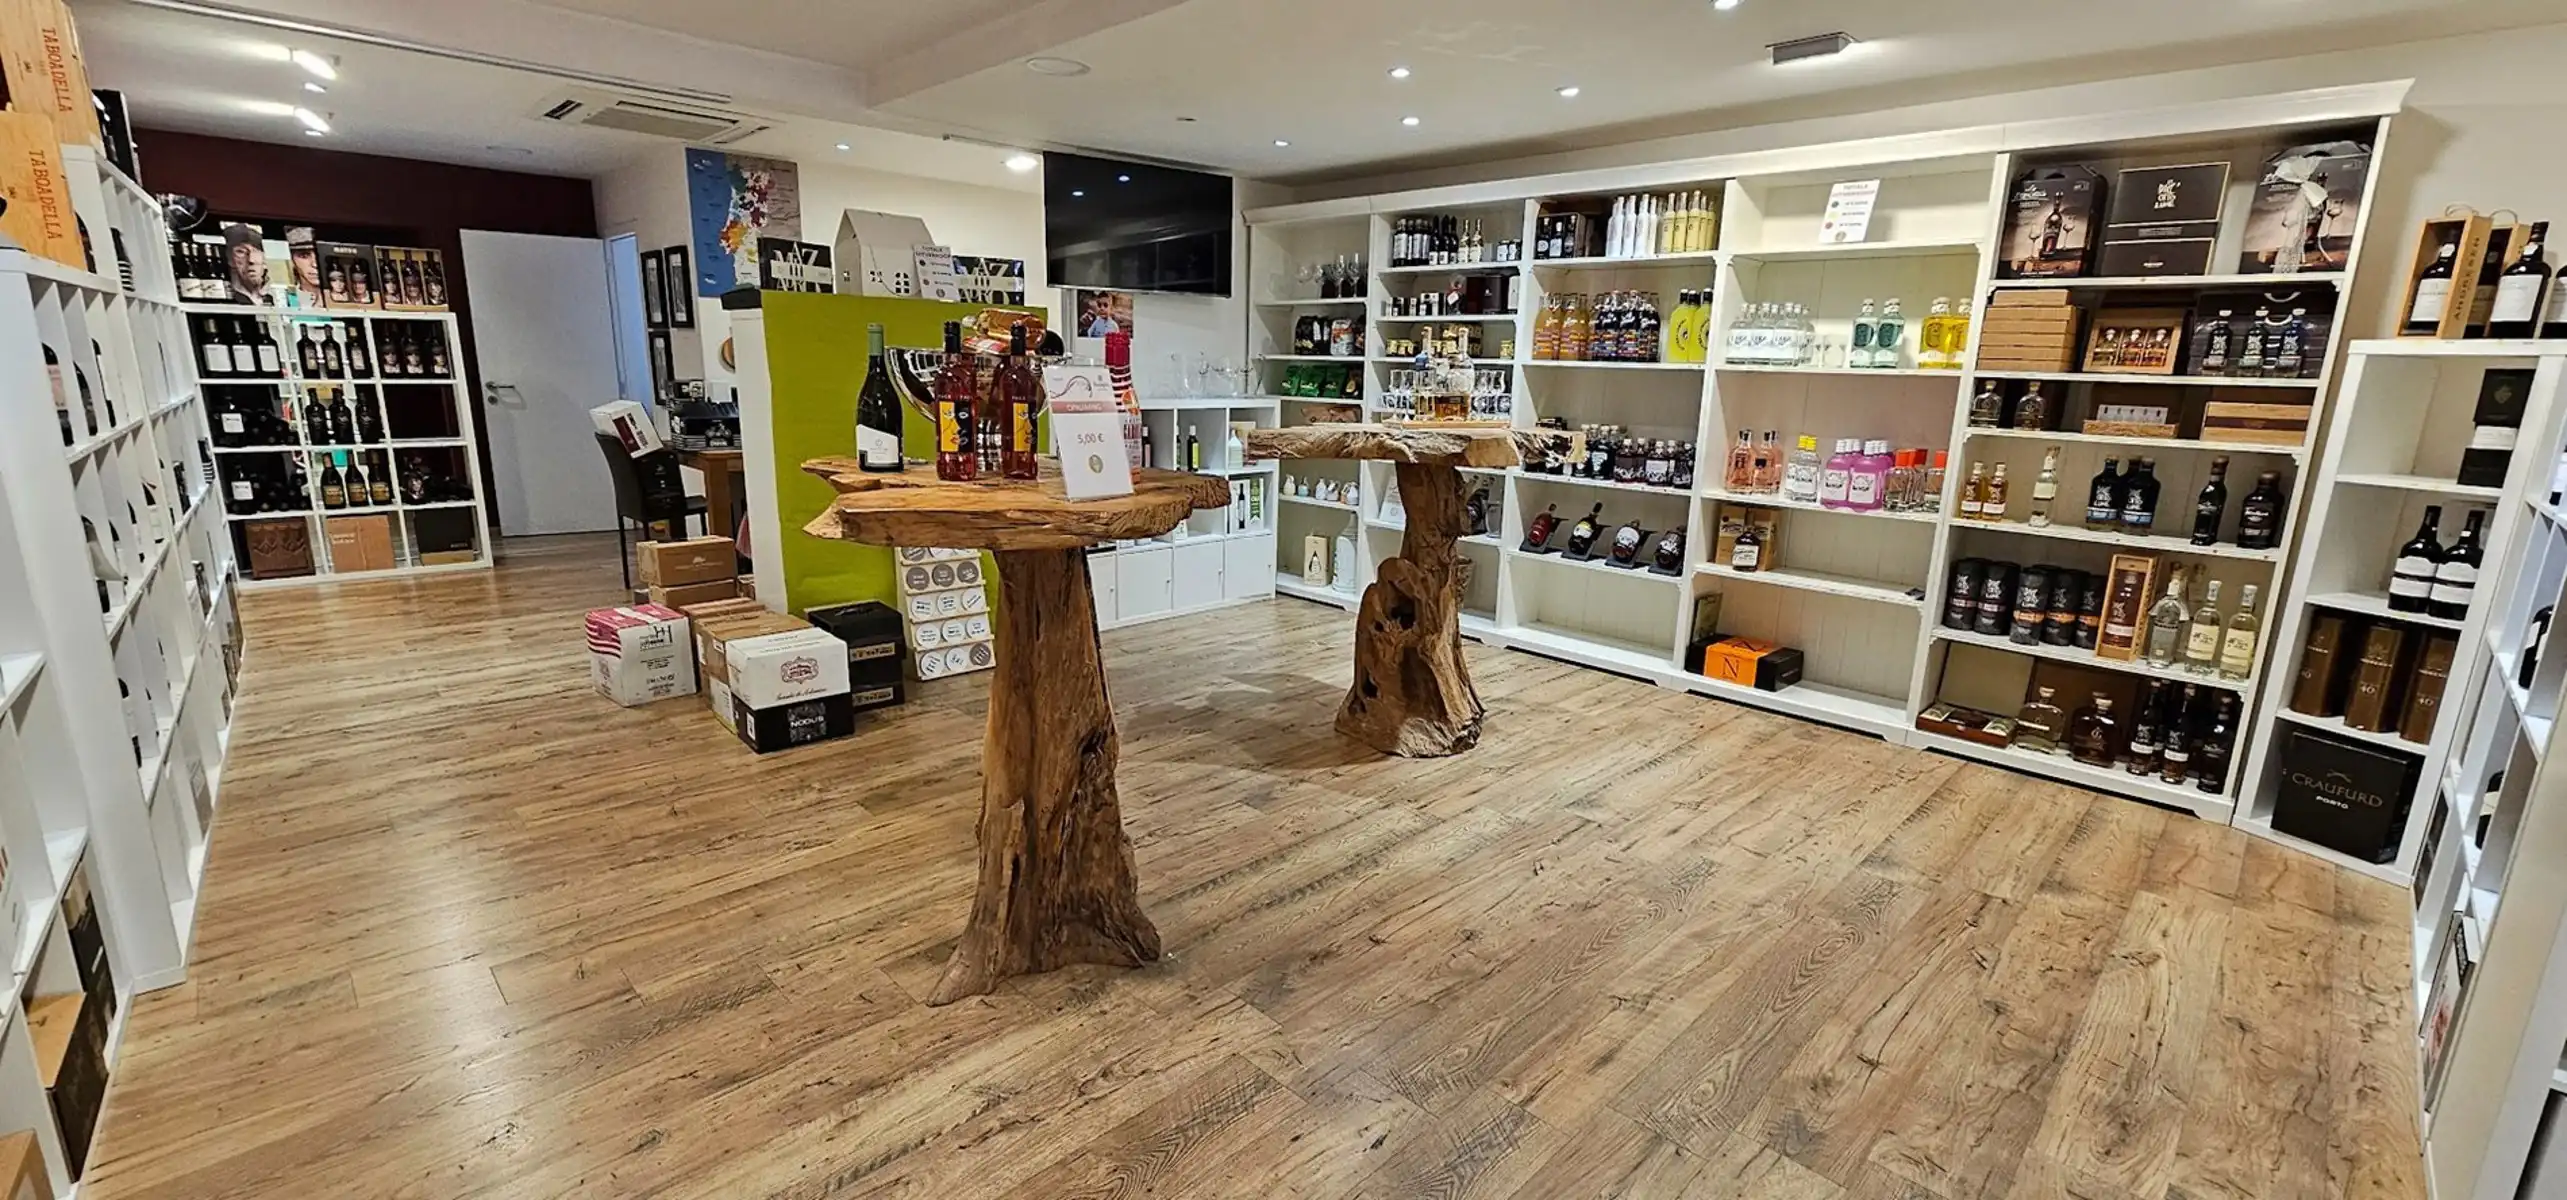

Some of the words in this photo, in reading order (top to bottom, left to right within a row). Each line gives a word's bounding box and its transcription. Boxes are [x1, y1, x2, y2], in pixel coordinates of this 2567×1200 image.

[41, 27, 73, 113] TABOADELLA
[29, 149, 63, 240] TABOADELLA
[1077, 433, 1097, 445] 5,00
[1098, 433, 1105, 443] €
[1721, 655, 1740, 680] N
[2360, 684, 2376, 695] 40
[2418, 697, 2434, 707] 40
[2292, 772, 2383, 808] CRAUFURD
[2316, 795, 2349, 810] PORTO
